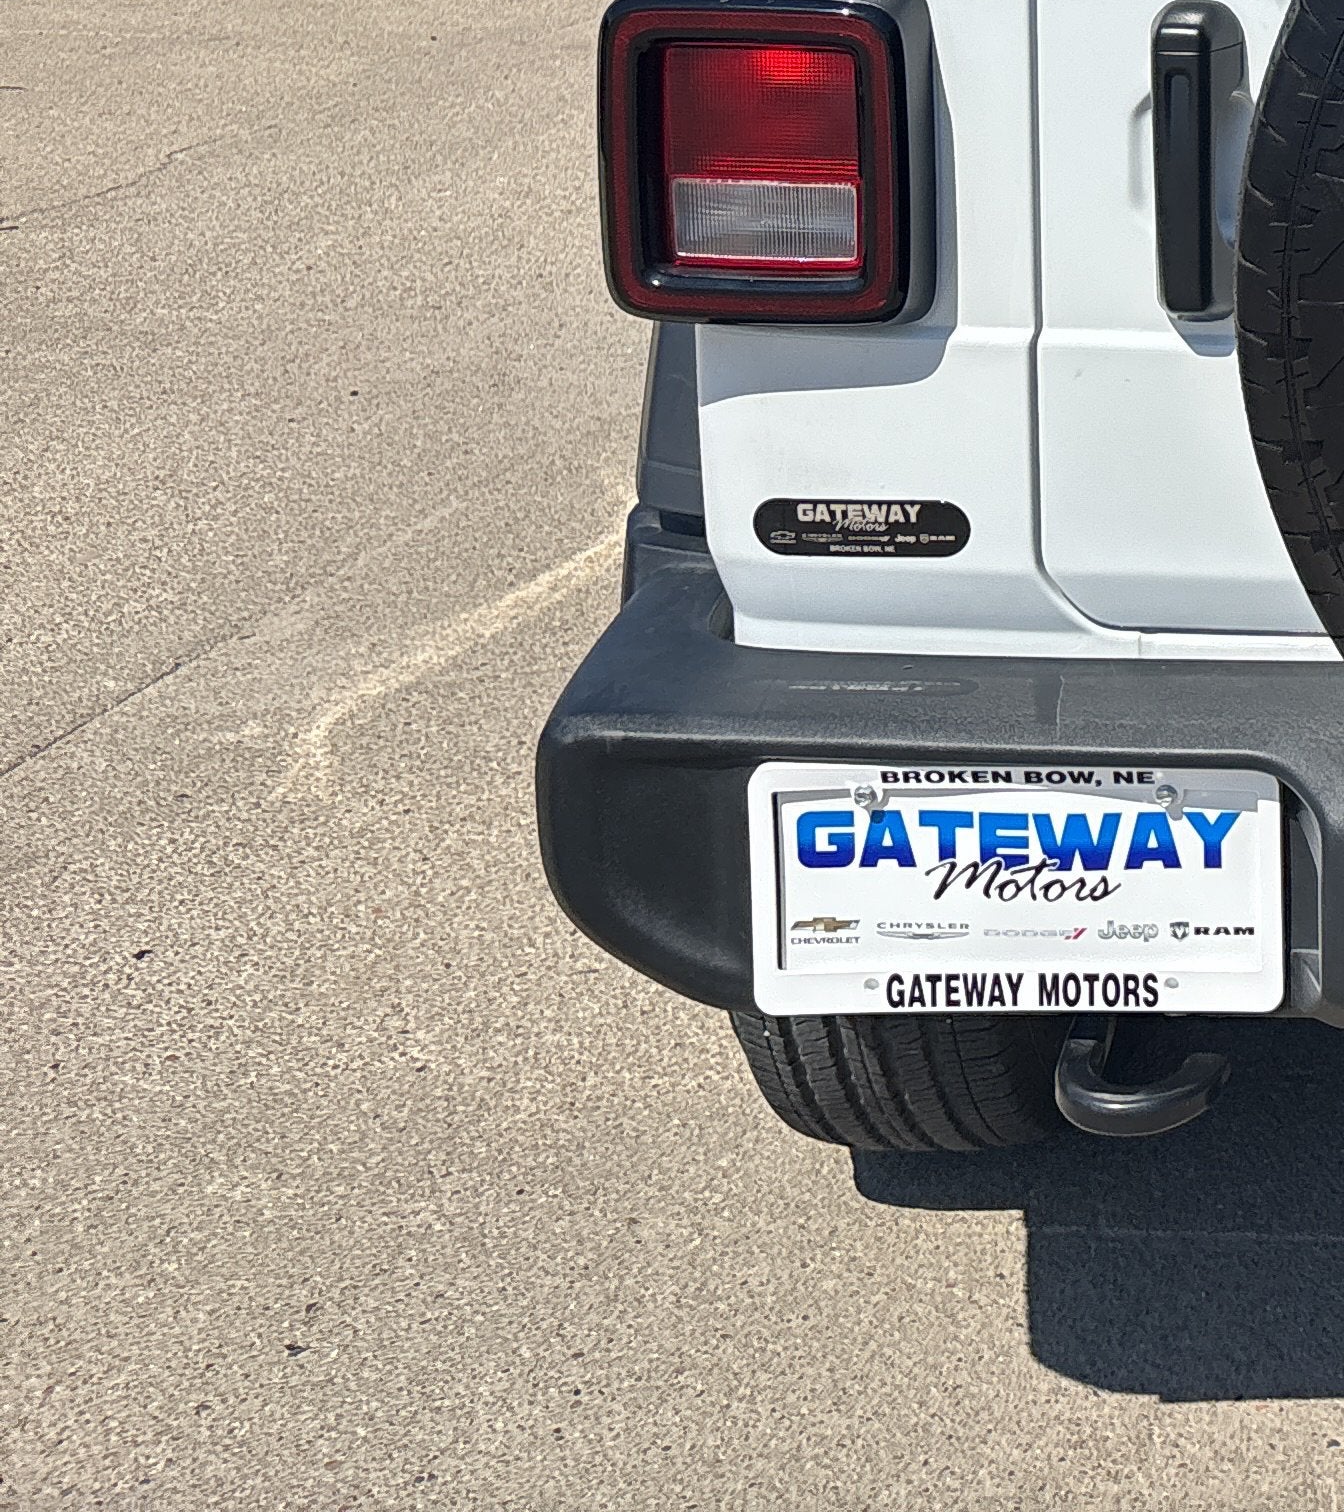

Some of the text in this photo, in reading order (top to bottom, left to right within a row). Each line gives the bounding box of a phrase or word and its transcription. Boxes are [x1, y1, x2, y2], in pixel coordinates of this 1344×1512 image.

[797, 503, 921, 523] GATEWAY
[832, 518, 890, 532] Motors
[880, 770, 1155, 788] BROKEN BOW, NE
[796, 810, 1241, 871] GATEWAY
[925, 856, 1121, 903] Motors
[876, 922, 970, 930] CHRYSLER
[1098, 920, 1160, 943] Jeep
[1194, 927, 1256, 936] RAM
[791, 936, 861, 945] CHEVROLET
[886, 973, 1159, 1008] GATEWAY MOTORS
